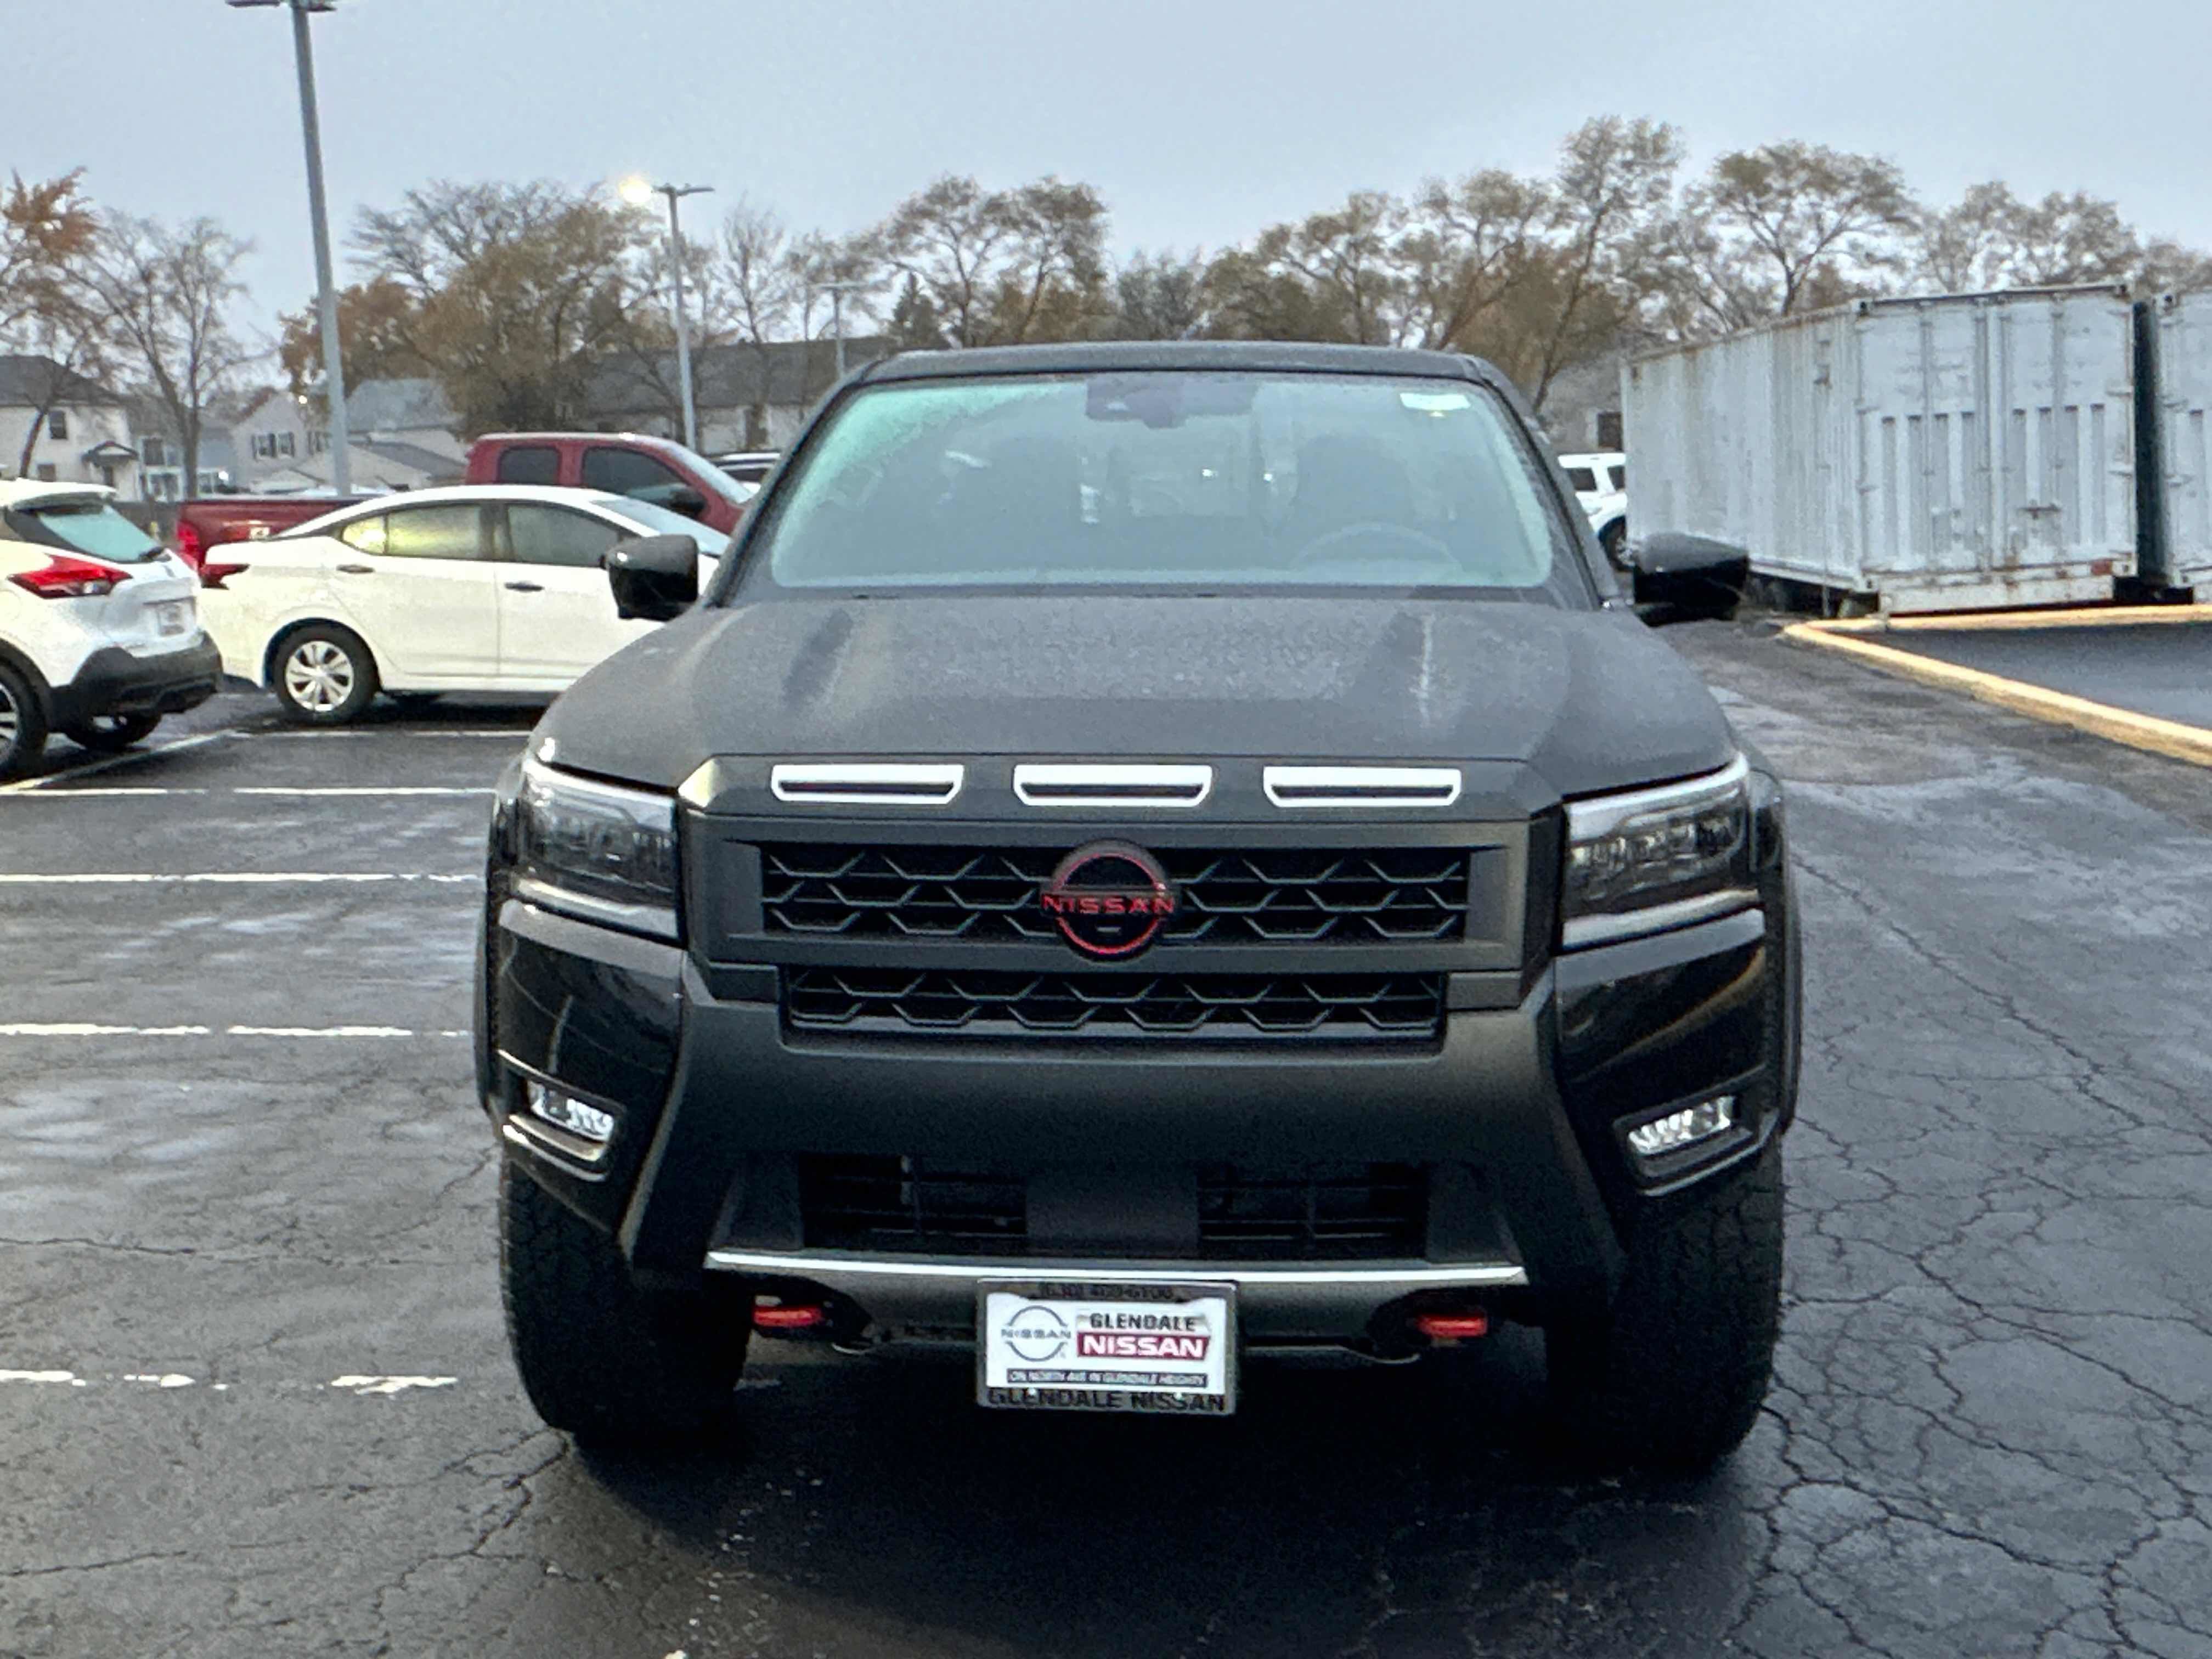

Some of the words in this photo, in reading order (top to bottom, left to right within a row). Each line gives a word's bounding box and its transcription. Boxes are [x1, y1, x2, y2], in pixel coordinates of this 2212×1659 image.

[1042, 895, 1173, 913] NISSAN
[1090, 1313, 1196, 1330] GLENDALE
[1002, 1329, 1071, 1339] NISSAN
[1083, 1336, 1204, 1357] NISSAN
[989, 1387, 1121, 1408] GLENDALE
[1131, 1394, 1225, 1412] NISSAN
